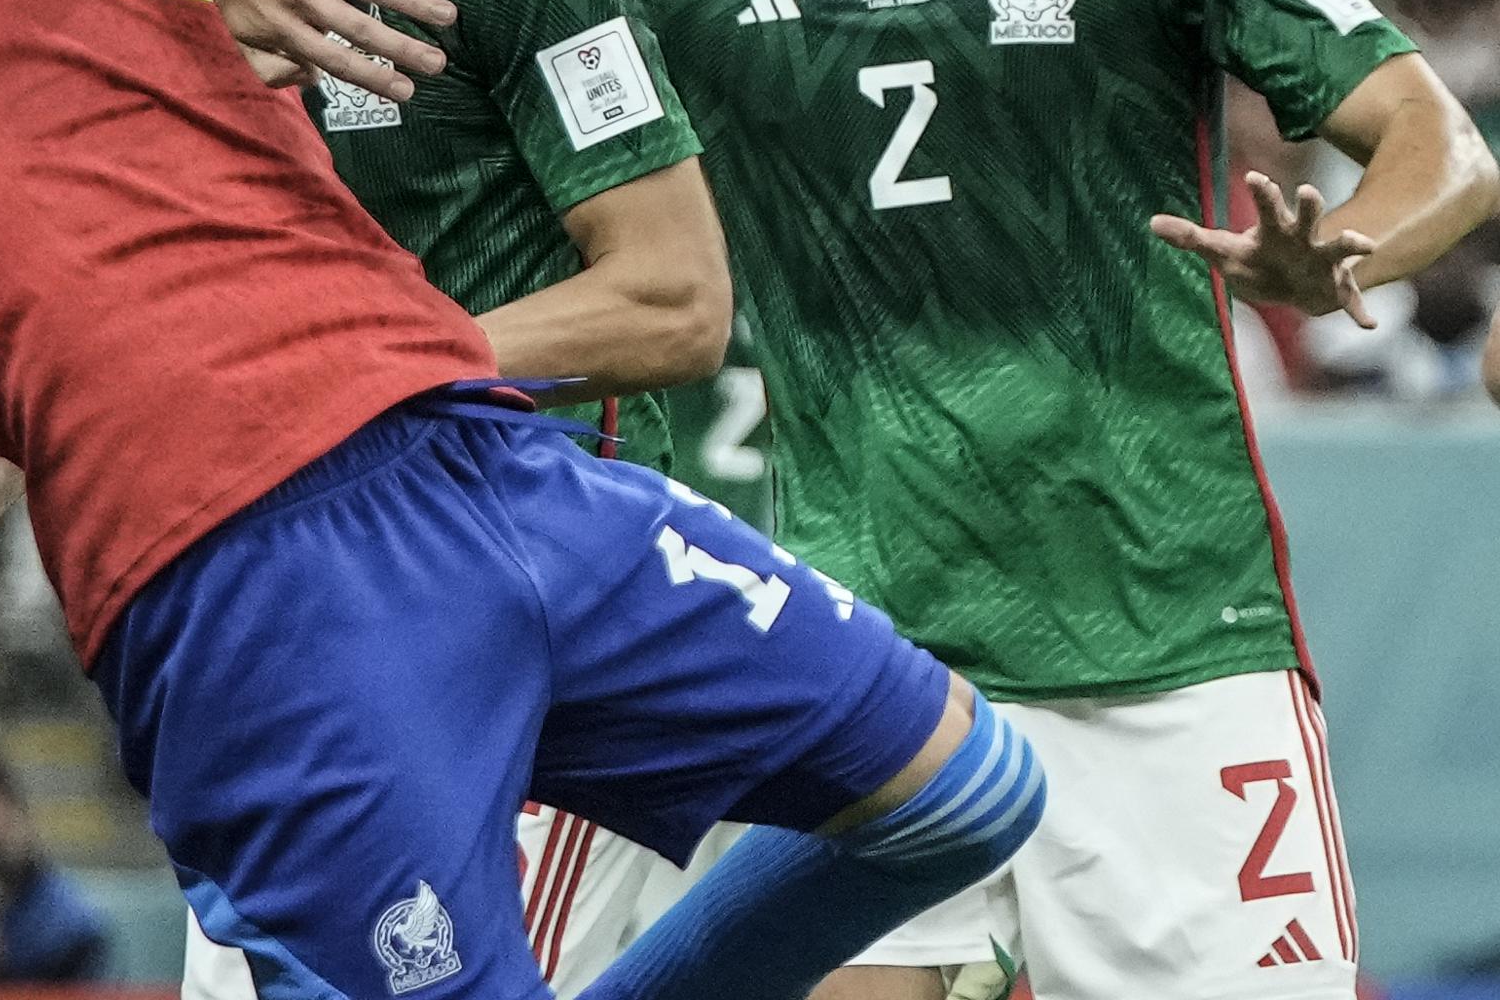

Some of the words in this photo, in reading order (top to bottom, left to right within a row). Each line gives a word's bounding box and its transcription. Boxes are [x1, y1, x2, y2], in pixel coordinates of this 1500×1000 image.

[994, 21, 1073, 39] MÉXICO
[586, 78, 623, 101] UNITES
[328, 106, 398, 128] MÉXICO
[858, 60, 953, 210] 2
[1220, 759, 1316, 902] 2
